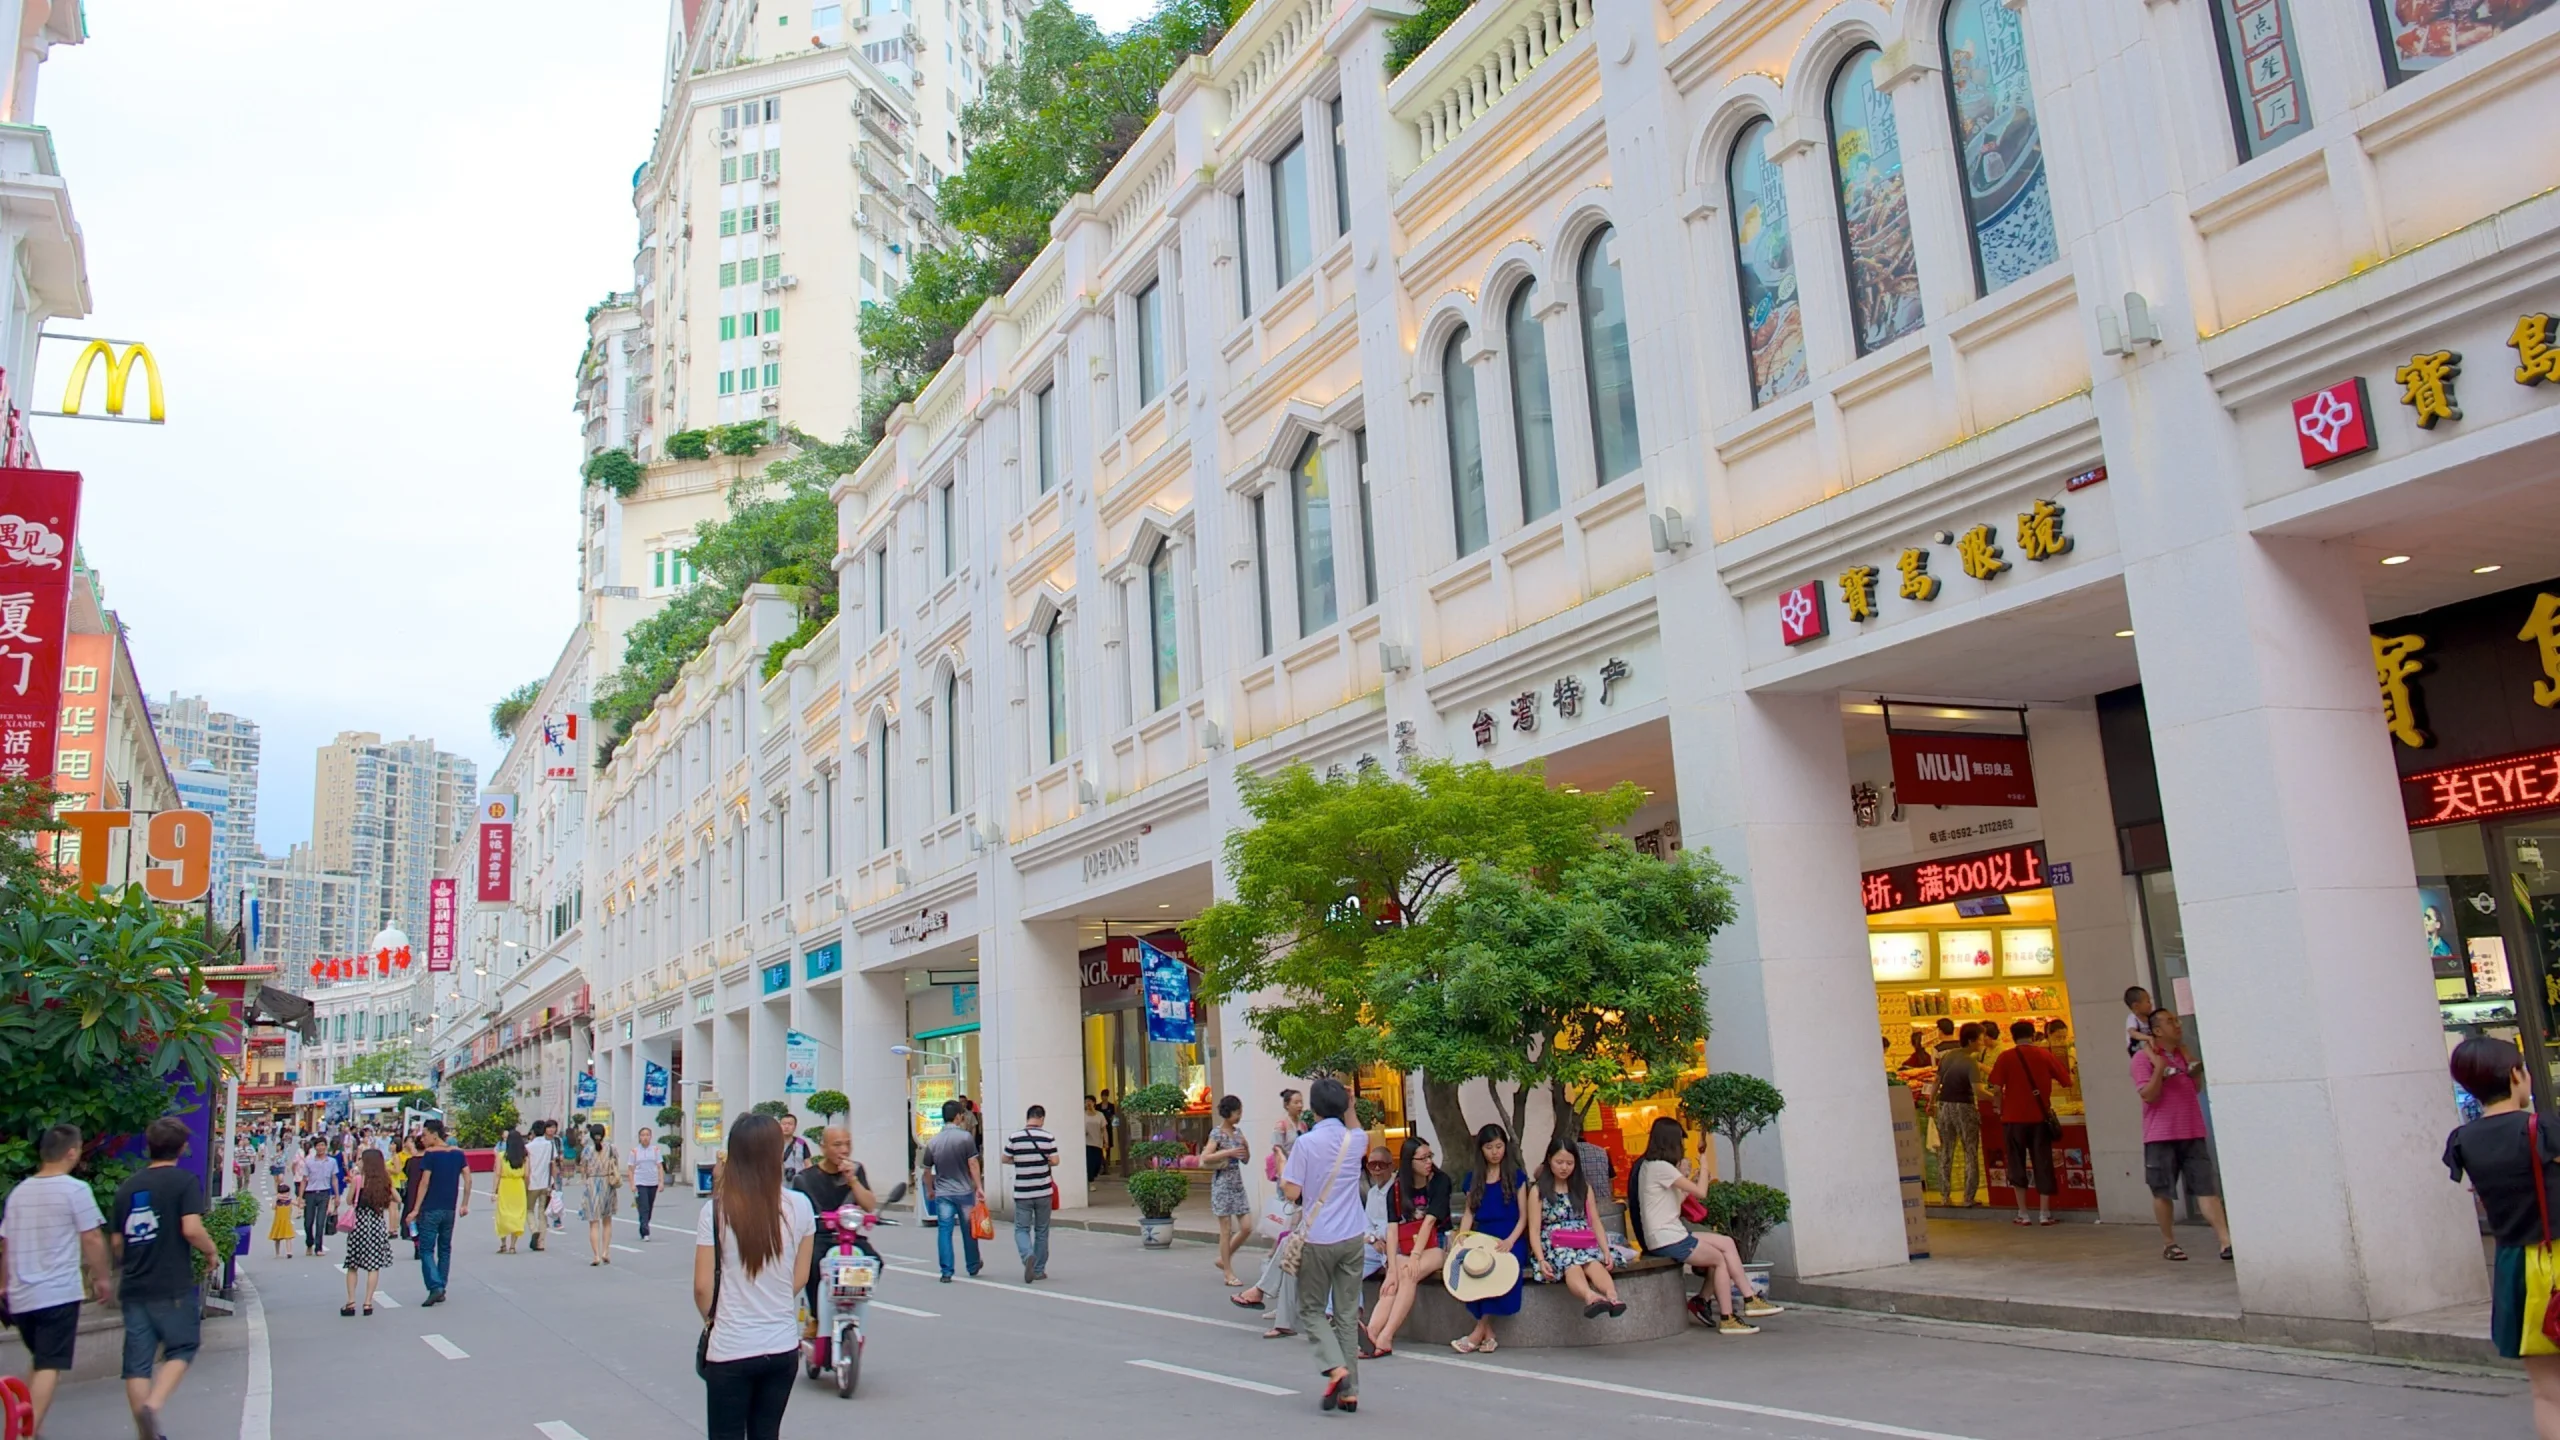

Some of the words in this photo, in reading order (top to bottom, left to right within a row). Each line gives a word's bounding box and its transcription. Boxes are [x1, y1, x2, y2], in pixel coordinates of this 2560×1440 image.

[1472, 656, 1633, 748] 台湾特产
[1916, 752, 1971, 782] MUJI
[1972, 761, 2014, 777] 無印良品
[1082, 837, 1140, 882] JOEONE
[2052, 872, 2070, 884] 276
